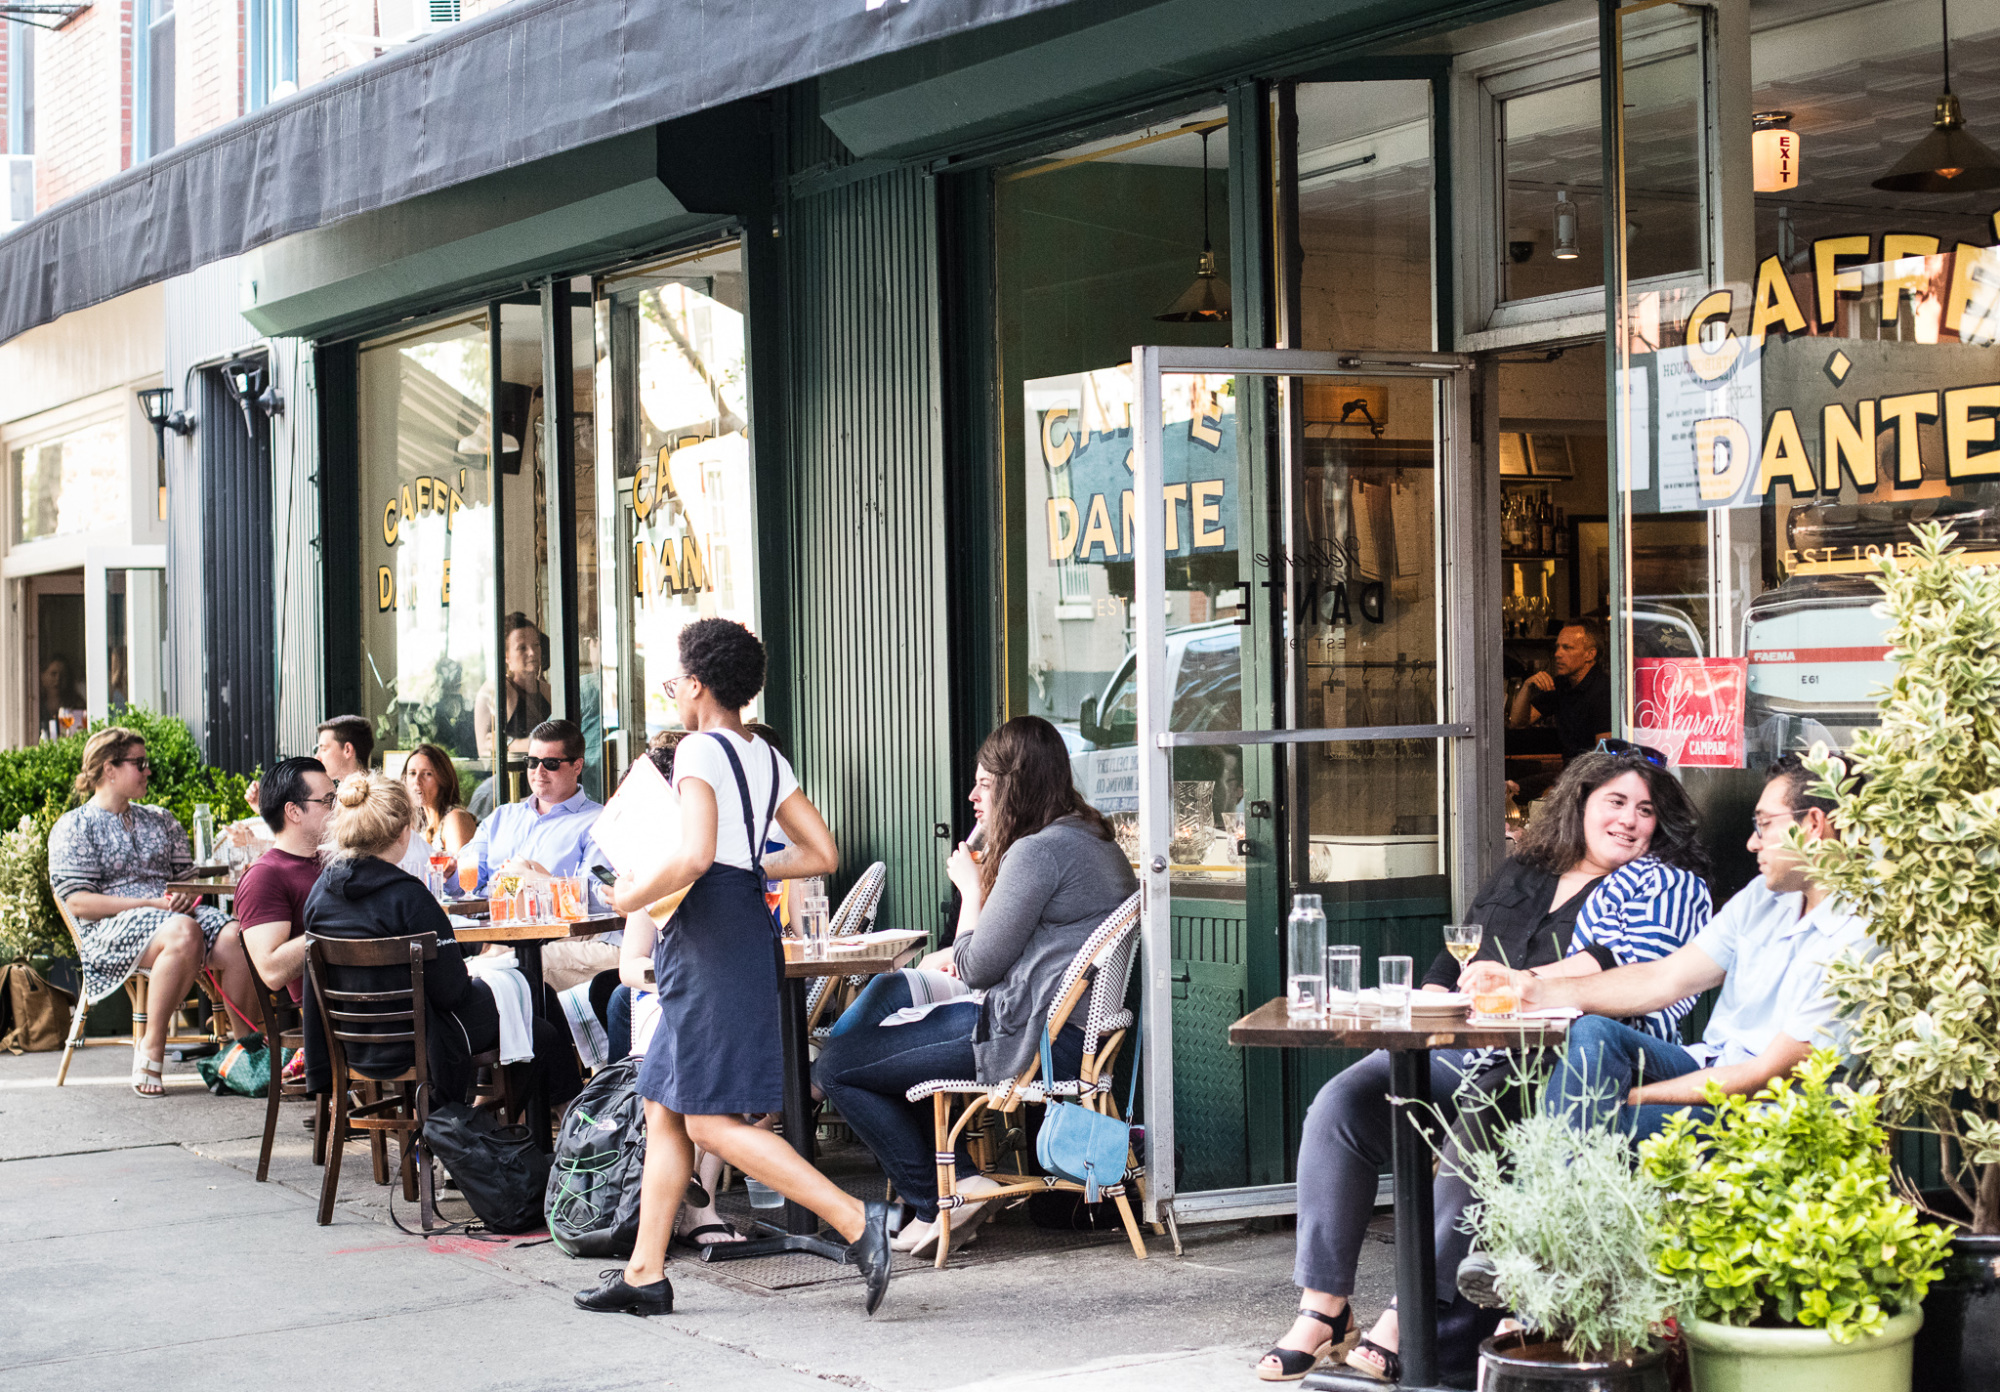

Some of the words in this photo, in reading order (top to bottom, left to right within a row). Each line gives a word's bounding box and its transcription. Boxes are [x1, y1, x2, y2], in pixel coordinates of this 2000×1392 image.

[1779, 136, 1791, 183] EXIT
[1693, 384, 2000, 509] DANTE
[1784, 546, 1838, 573] EST
[1097, 597, 1128, 617] EST
[1753, 651, 1796, 662] FAEMA
[1689, 740, 1727, 756] CAMPARI
